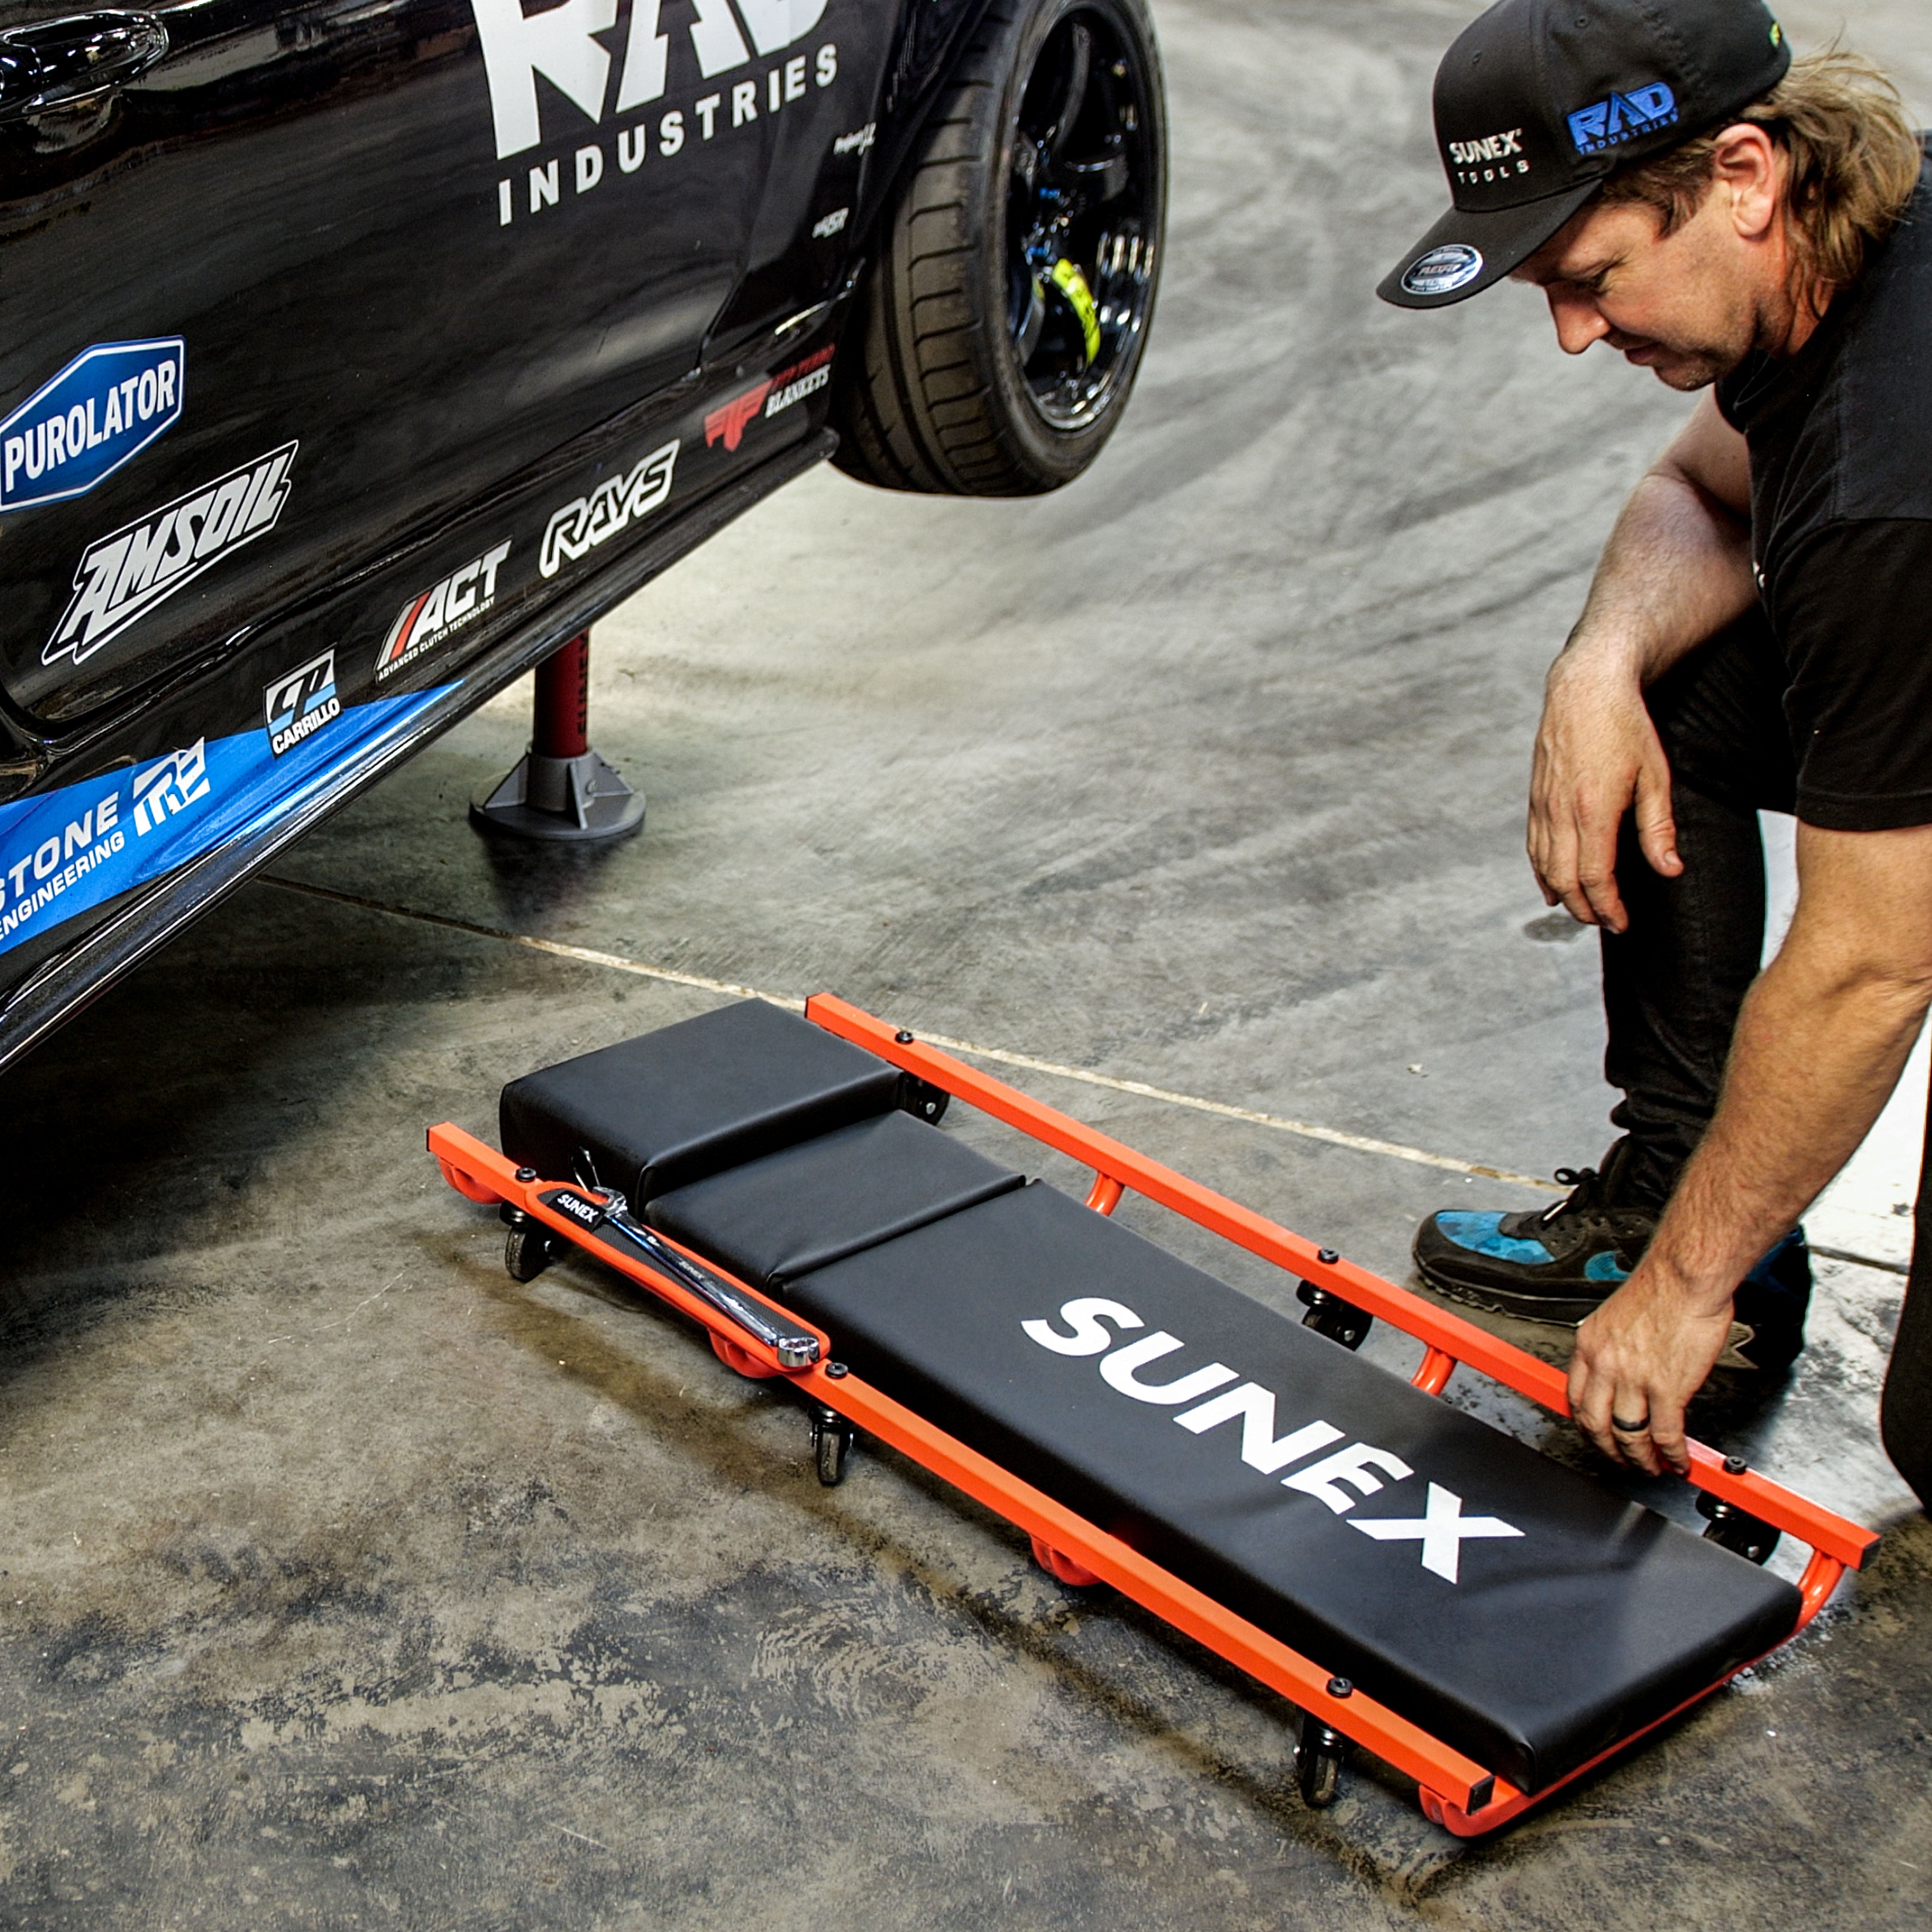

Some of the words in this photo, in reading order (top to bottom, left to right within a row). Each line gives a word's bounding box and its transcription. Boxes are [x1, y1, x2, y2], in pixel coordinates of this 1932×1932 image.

[498, 43, 837, 226] INDUSTRIES
[1449, 129, 1523, 164] SUNEX
[1567, 82, 1675, 146] RAD
[1458, 159, 1530, 184] TOOLS
[5, 359, 176, 493] PUROLATOR
[57, 452, 290, 646] AMSOIL
[539, 439, 680, 578] RAYS
[379, 647, 419, 681] ADVANCED
[419, 628, 449, 653] CLUTCH
[449, 596, 495, 632] TECHNOLOGY
[406, 540, 512, 650] ACT
[272, 698, 340, 754] CARRILLO
[0, 792, 119, 912] TONE
[556, 1194, 599, 1223] SUNEX
[1020, 1297, 1526, 1584] SUNEX
